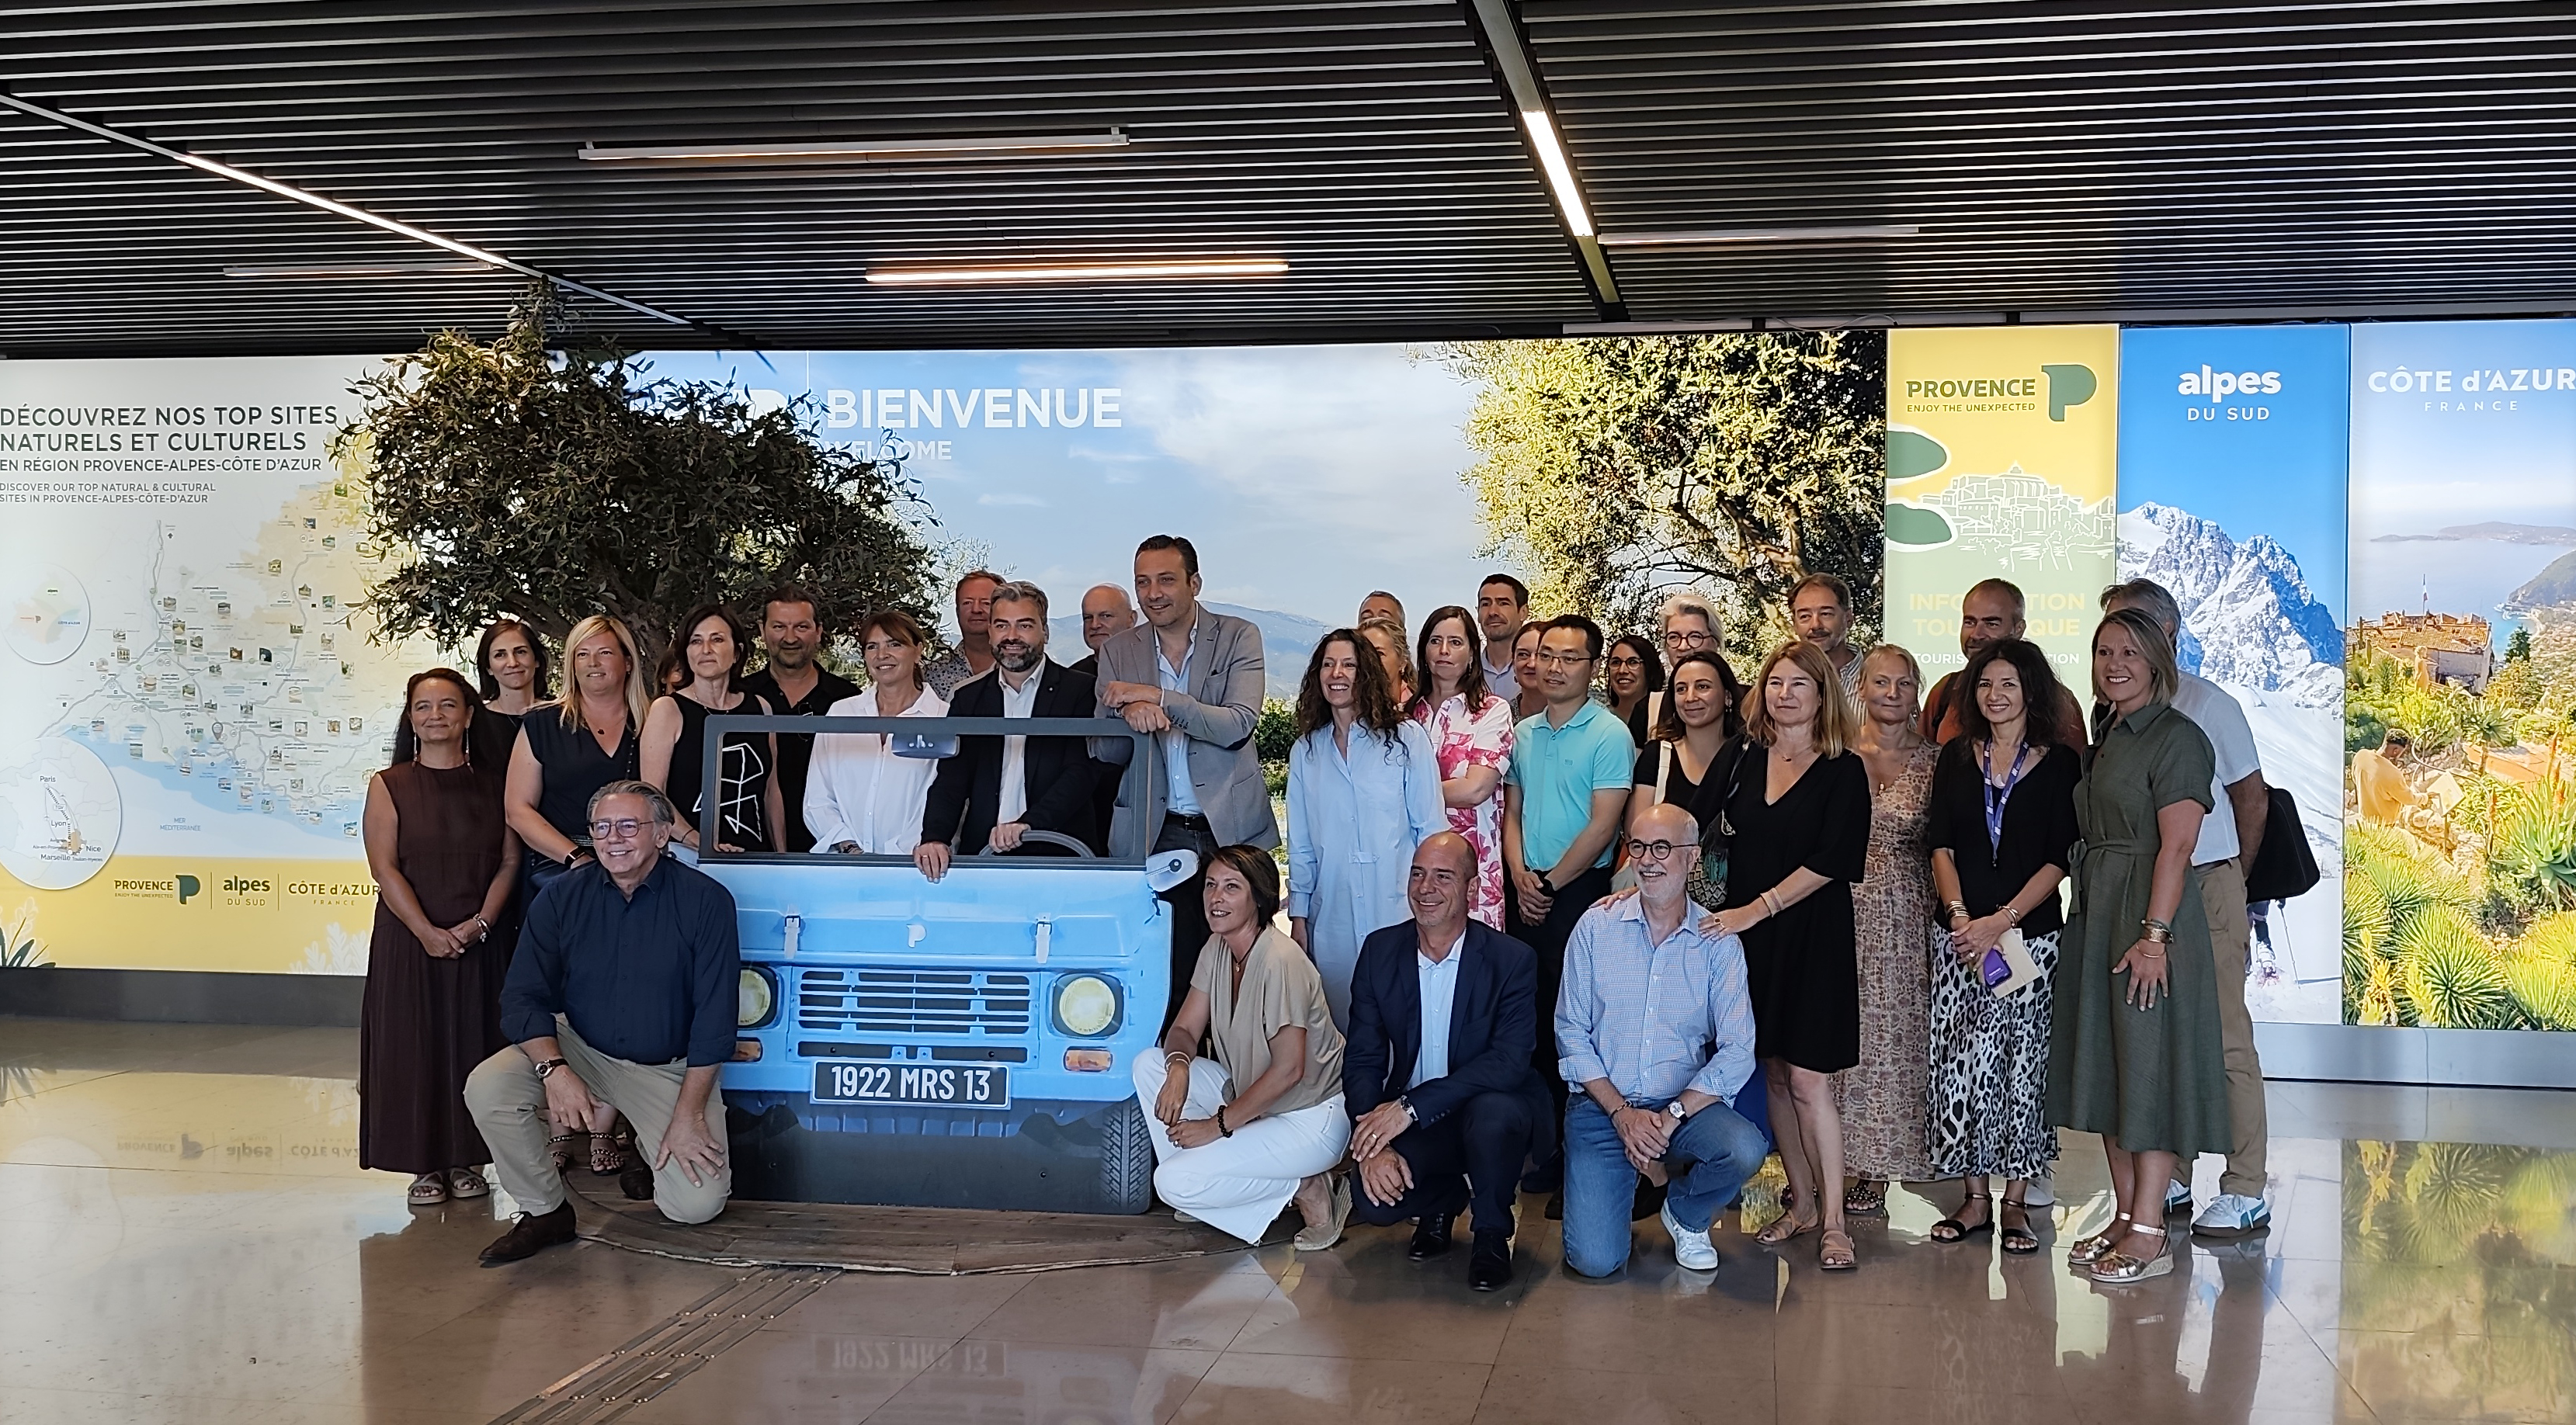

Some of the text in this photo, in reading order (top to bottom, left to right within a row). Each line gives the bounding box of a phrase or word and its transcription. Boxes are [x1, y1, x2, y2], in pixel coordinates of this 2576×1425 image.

[2178, 364, 2281, 403] alpes
[2368, 365, 2576, 393] CÔTE d'AZUR
[1906, 379, 2036, 397] PROVENCE
[828, 388, 1123, 428] BIENVENUE
[1907, 403, 2036, 412] ENJOY THE UNEXPECTED
[2425, 400, 2517, 411] FRANCE
[1, 404, 338, 426] DÉCOUVREZ NOS TOP SITES
[2188, 407, 2269, 421] DU SUD
[1, 432, 306, 452] NATURELS ET CULTURELS
[0, 456, 321, 472] EN RÉGION PROVENCE-ALPES-CÔTE D'AZUR
[0, 483, 216, 492] DISCOVER OUR TOP NATURAL & CULTURAL
[0, 493, 208, 503] SITES IN PROVENCE-ALPES-CÔTE-D'AZUR
[1909, 592, 2085, 611] INFTION
[1912, 619, 2080, 636] TOUQUE
[1914, 653, 1966, 664] TOURIS
[114, 879, 173, 891] PROVENCE
[223, 875, 271, 896] alpes
[288, 880, 325, 894] CÔTE
[227, 898, 266, 907] DU SUD
[831, 1066, 991, 1101] 1922 MRS 13
